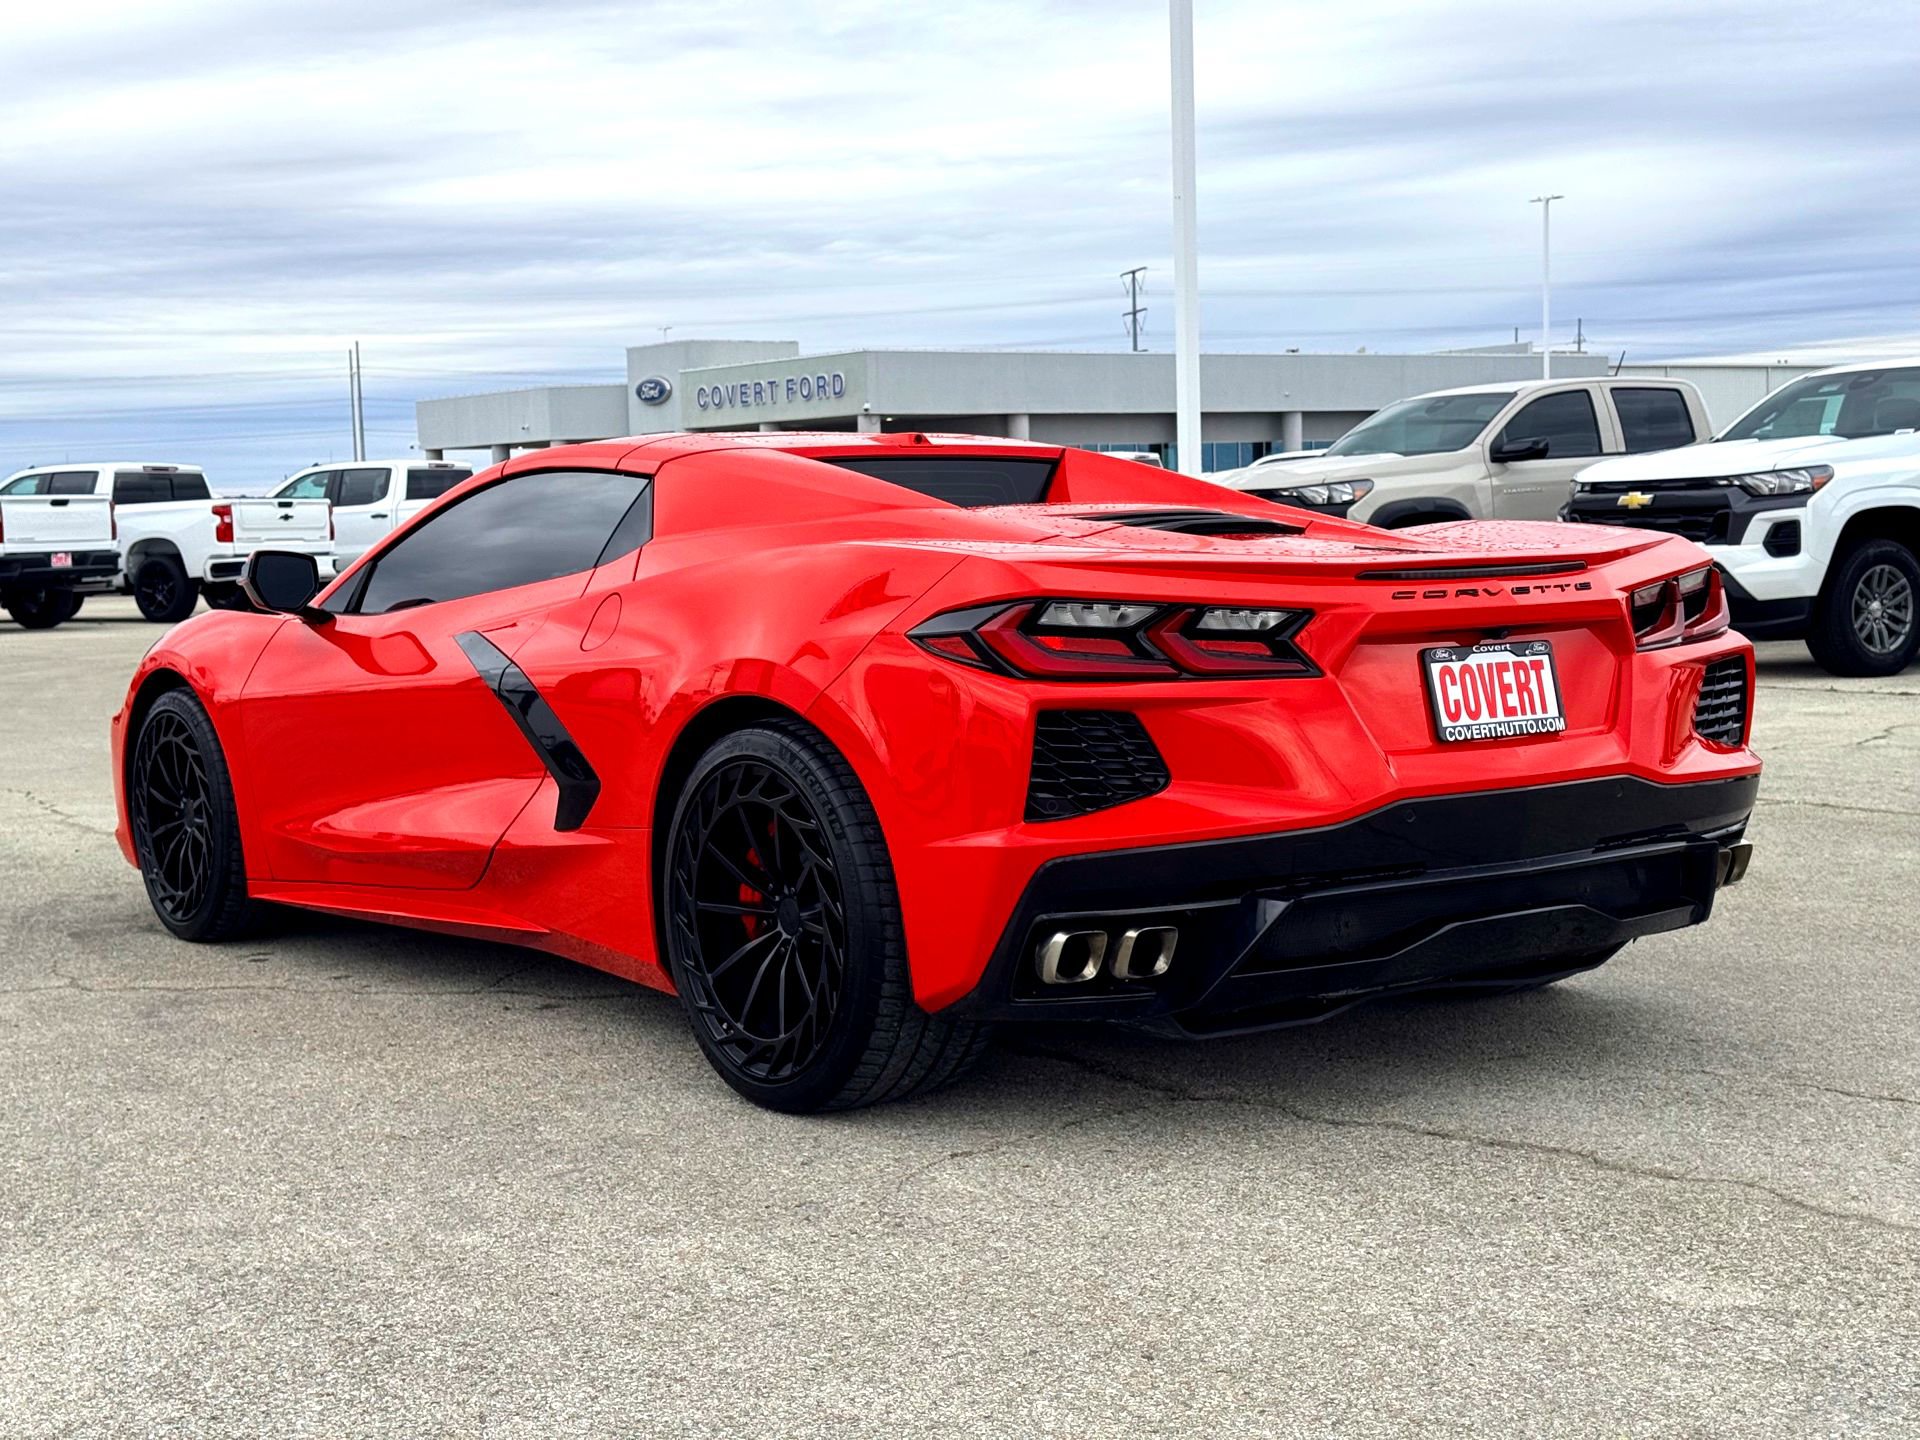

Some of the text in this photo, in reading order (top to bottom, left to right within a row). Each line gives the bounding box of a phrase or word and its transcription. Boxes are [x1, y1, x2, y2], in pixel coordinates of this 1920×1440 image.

[697, 373, 845, 409] COVERT FORD
[1391, 582, 1592, 600] CORVETTE
[1472, 643, 1511, 653] Covert
[1439, 659, 1548, 722] COVERT
[1445, 717, 1566, 741] COVERTHUTTO.COM
[790, 755, 846, 840] MICHELIN
